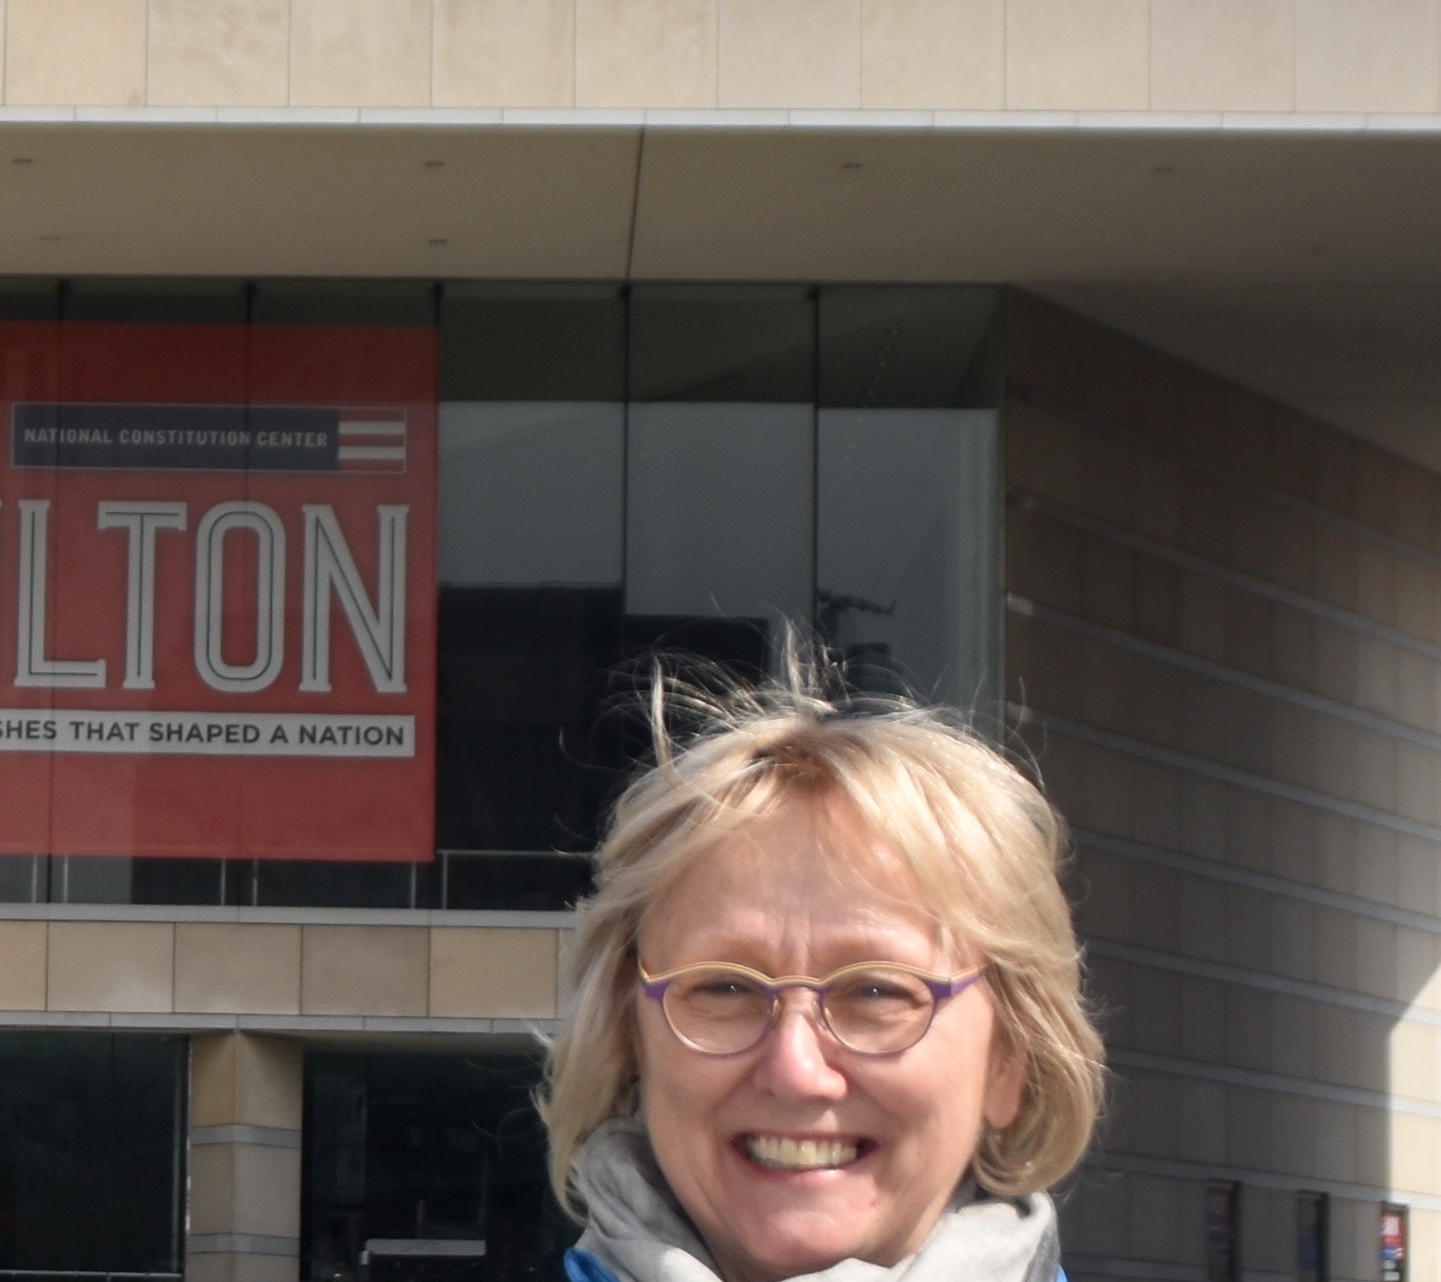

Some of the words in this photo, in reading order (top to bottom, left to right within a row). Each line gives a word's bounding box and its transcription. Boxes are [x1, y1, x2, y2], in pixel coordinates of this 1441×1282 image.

[23, 427, 113, 444] NATIONAL
[119, 428, 252, 447] CONSTITUTION
[256, 430, 329, 448] CENTER
[69, 720, 141, 742] THAT
[148, 722, 261, 745] SHAPED
[269, 724, 290, 745] A
[298, 724, 406, 746] NATION
